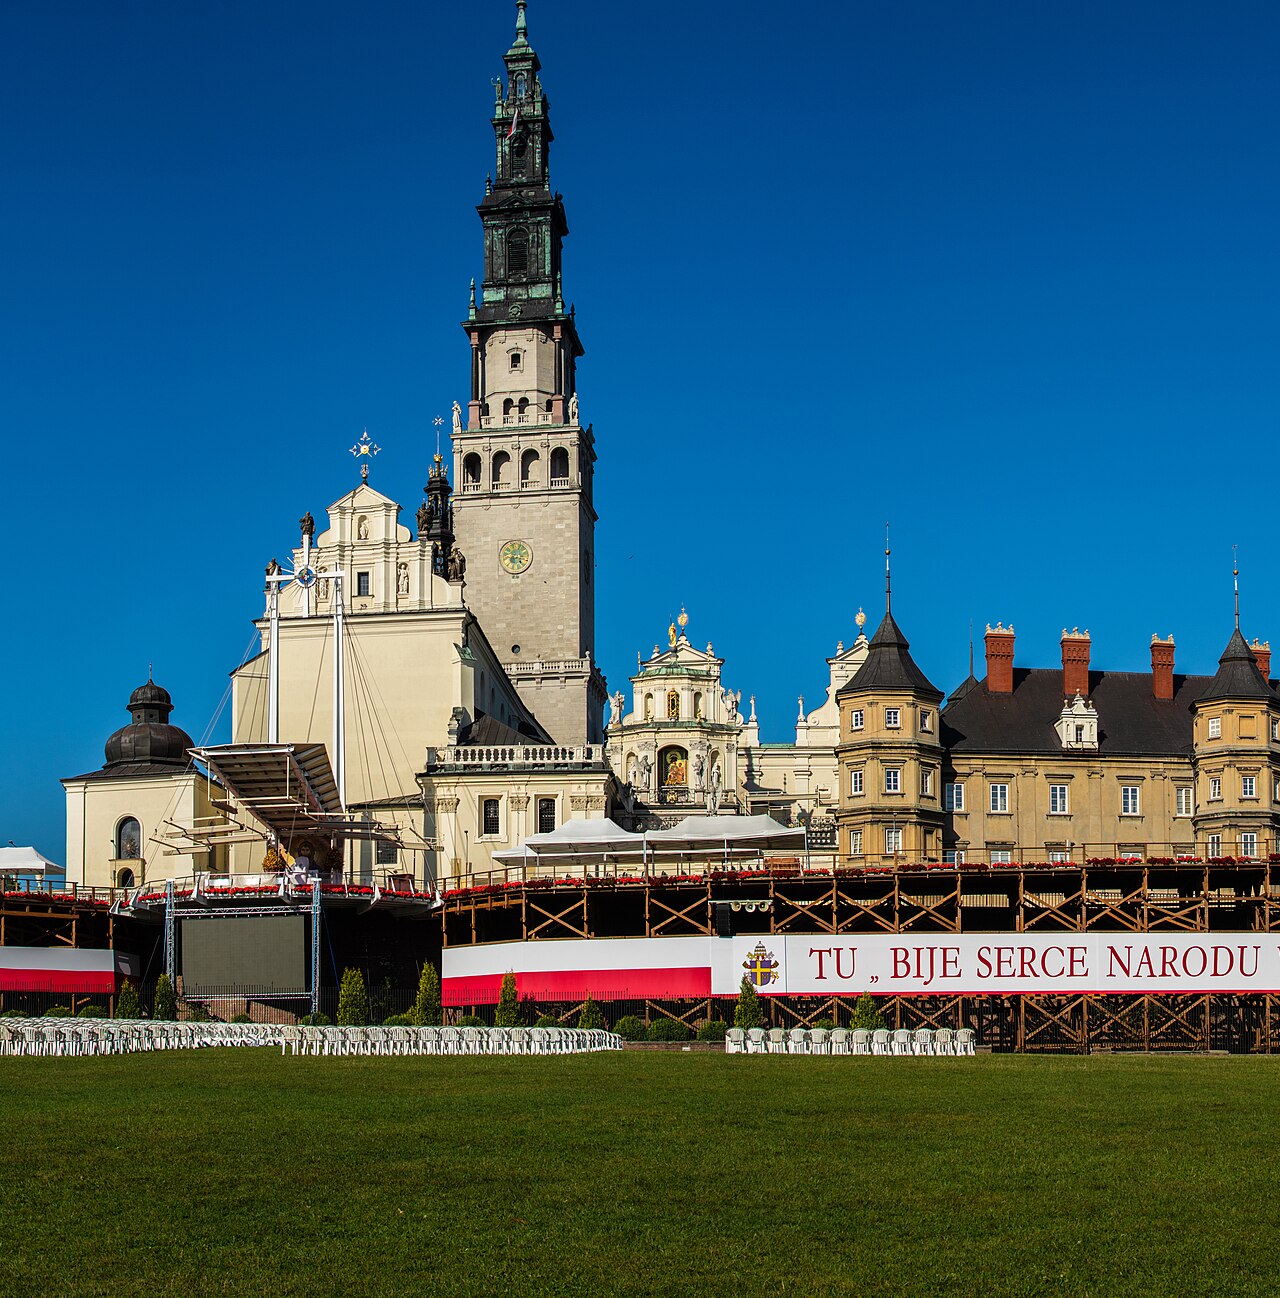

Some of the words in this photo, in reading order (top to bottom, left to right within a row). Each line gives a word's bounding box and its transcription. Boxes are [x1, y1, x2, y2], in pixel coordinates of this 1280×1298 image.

[808, 947, 858, 980] TU
[976, 945, 1090, 979] SERCE
[1107, 945, 1262, 978] NARODU
